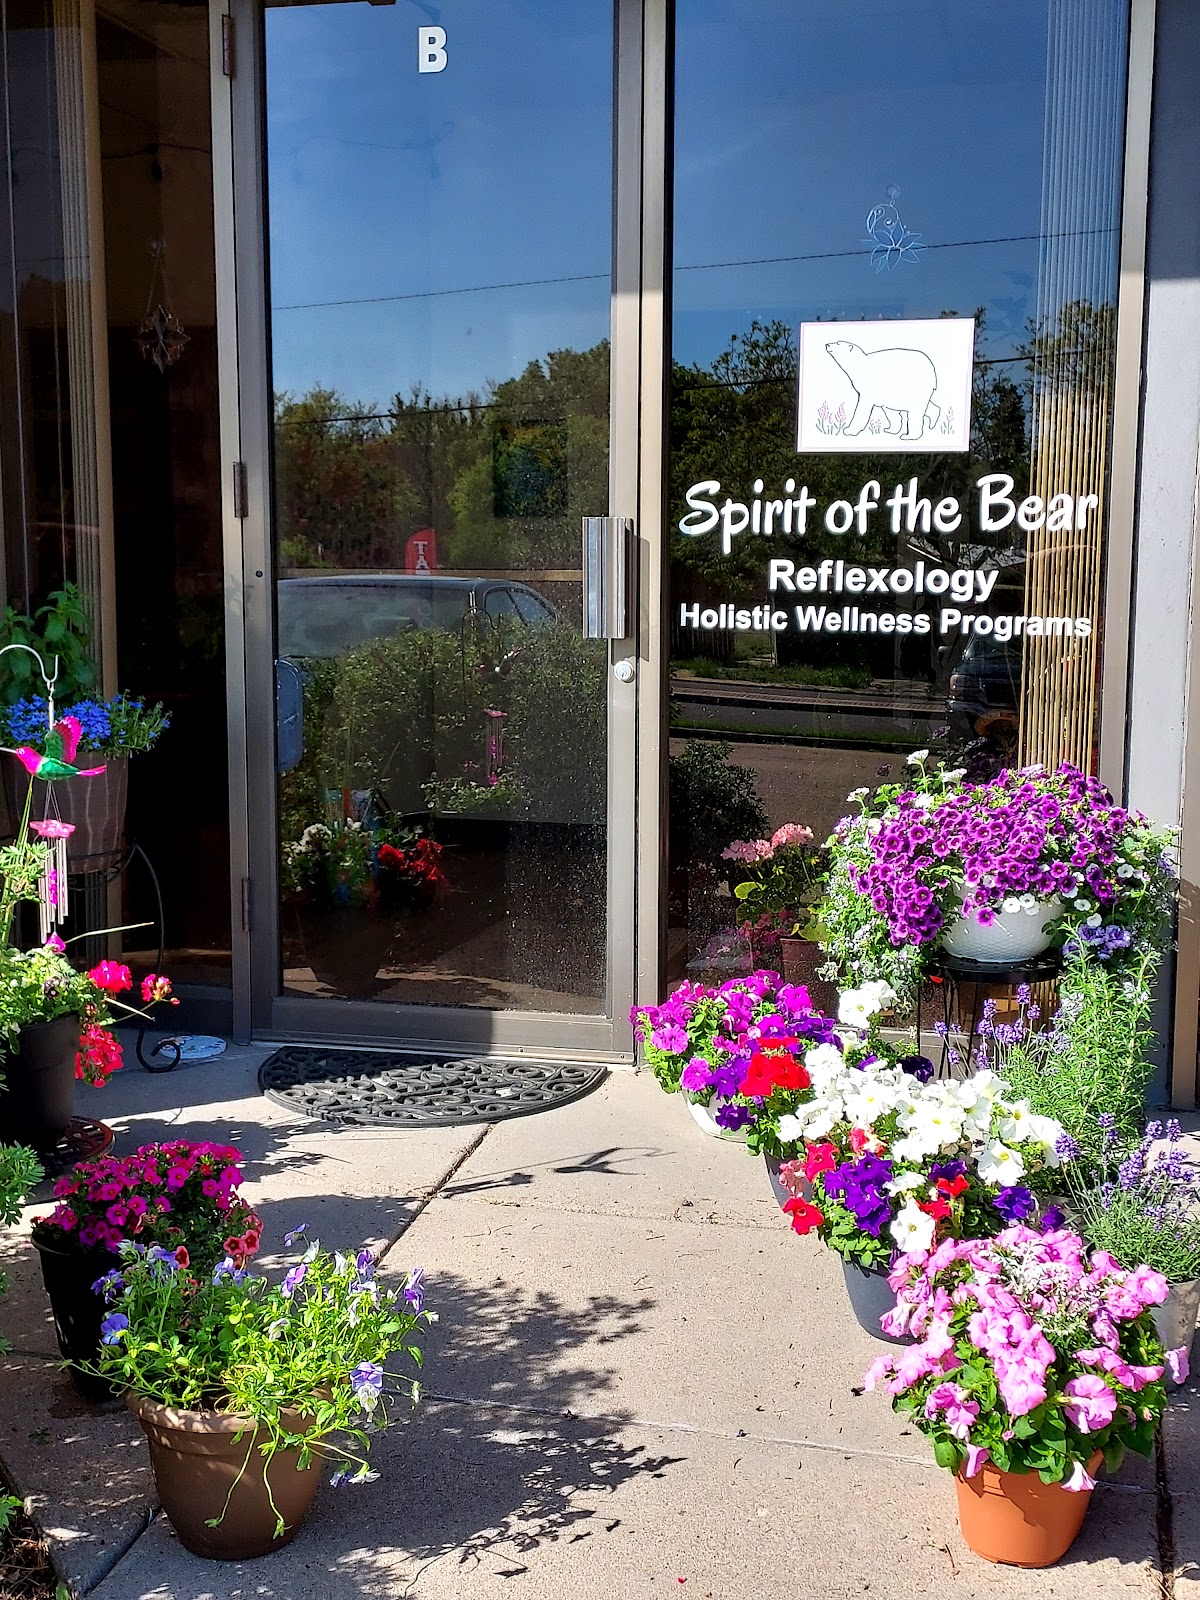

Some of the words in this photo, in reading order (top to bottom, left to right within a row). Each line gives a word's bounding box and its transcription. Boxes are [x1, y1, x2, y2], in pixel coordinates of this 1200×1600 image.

[418, 26, 448, 73] B
[679, 478, 816, 555] Spirit
[825, 480, 880, 534] of
[887, 476, 962, 533] the
[976, 473, 1099, 533] Bear
[768, 558, 999, 603] Reflexology
[680, 602, 788, 630] Holistic
[796, 606, 931, 633] Wellness
[941, 608, 1092, 641] Programs
